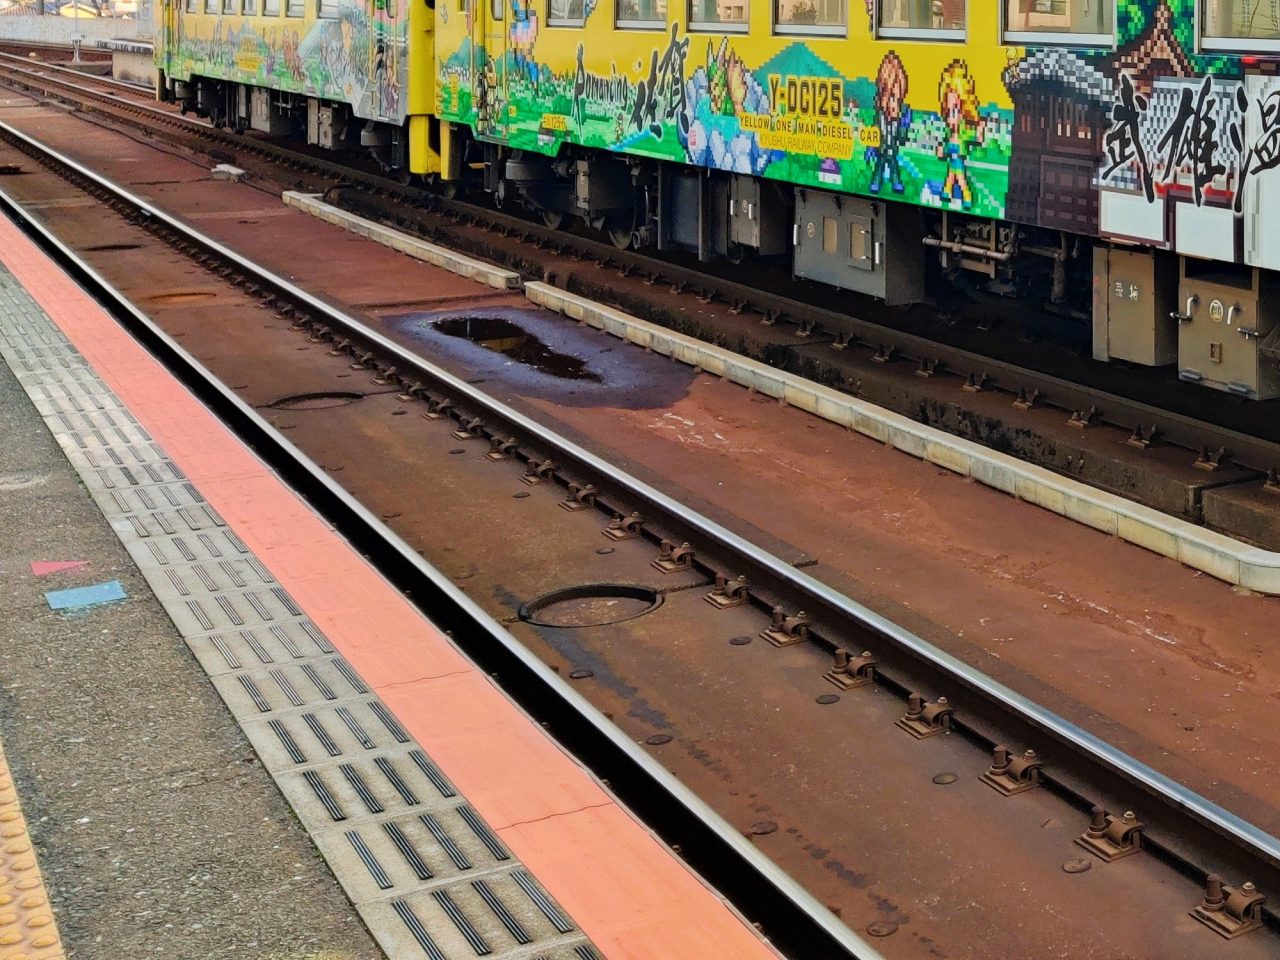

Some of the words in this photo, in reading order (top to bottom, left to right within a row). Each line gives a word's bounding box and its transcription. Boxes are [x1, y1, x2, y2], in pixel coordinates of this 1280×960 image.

[769, 77, 842, 117] Y-DC125
[741, 116, 769, 129] YELLOW
[776, 119, 791, 132] ONE
[798, 121, 815, 135] MAN
[823, 124, 852, 140] DIESEL
[860, 128, 879, 142] CAR
[760, 132, 785, 147] KYUSHU
[788, 136, 815, 151] RAILWAY
[818, 140, 852, 158] COMPANY
